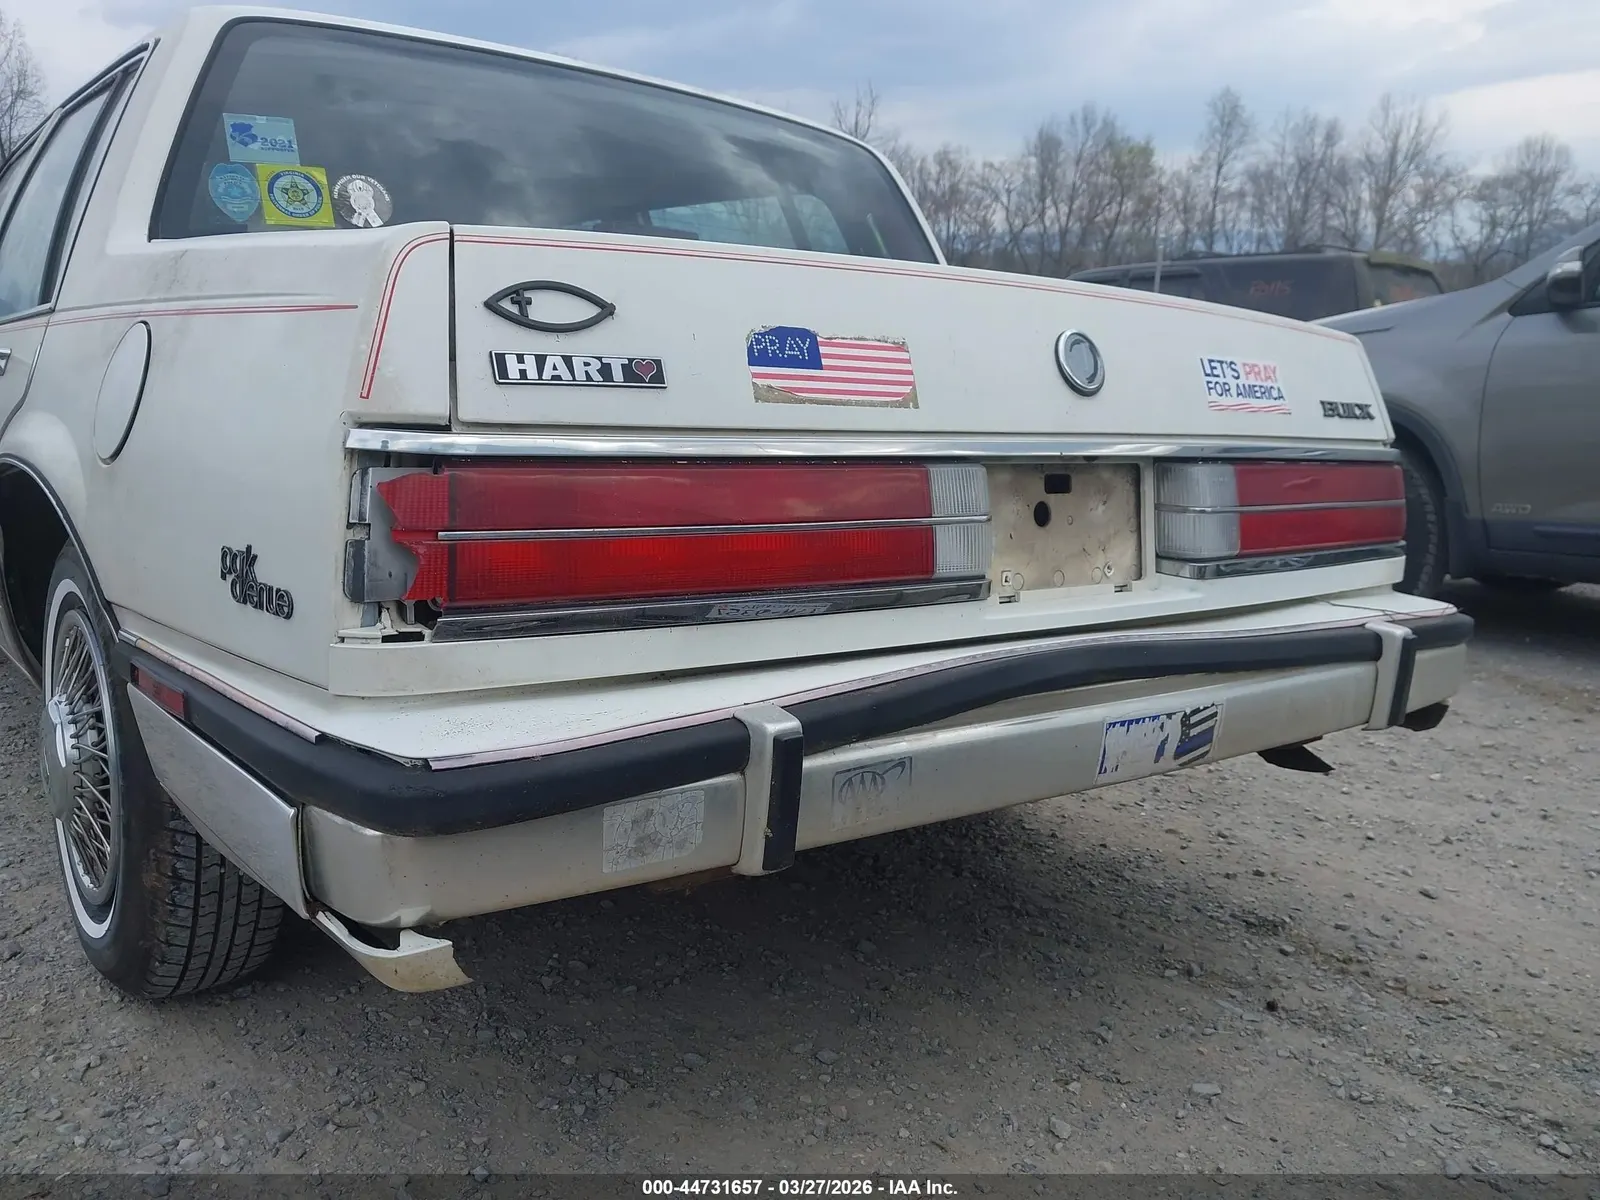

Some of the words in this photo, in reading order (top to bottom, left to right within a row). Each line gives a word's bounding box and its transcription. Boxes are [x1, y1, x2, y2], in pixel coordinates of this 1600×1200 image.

[260, 137, 294, 149] 2021
[367, 177, 391, 202] VETERANS
[751, 334, 811, 360] PRAY
[504, 354, 629, 383] HART
[1200, 358, 1241, 380] LET'S
[1242, 362, 1279, 383] PRAY
[1206, 380, 1233, 398] FOR
[1236, 385, 1286, 401] AMERICA
[1319, 400, 1376, 421] BUICK
